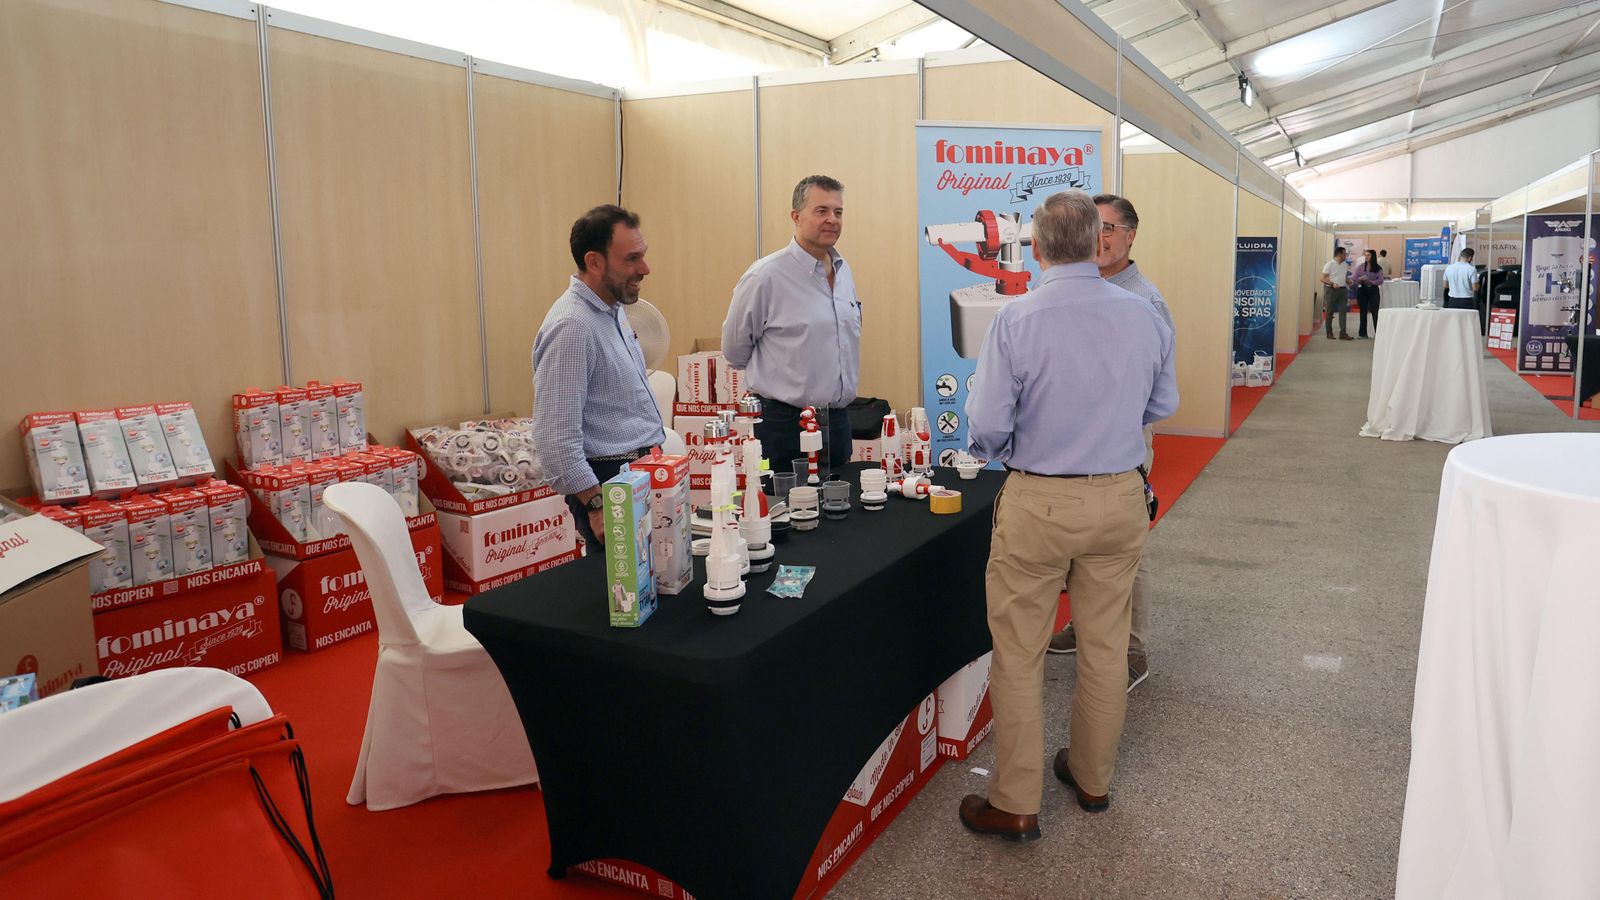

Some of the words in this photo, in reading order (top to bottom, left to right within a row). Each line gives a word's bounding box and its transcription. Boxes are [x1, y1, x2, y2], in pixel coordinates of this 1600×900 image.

[937, 169, 1012, 197] Original
[1027, 174, 1055, 190] Since
[1055, 172, 1073, 185] 1939
[1241, 307, 1271, 317] SPAS
[676, 403, 688, 412] QUE
[688, 403, 700, 413] NOS
[700, 403, 722, 414] COPIEN
[691, 477, 705, 486] NOS
[473, 500, 485, 512] QUE
[485, 498, 498, 509] NOS
[498, 494, 518, 508] COPIEN
[533, 487, 545, 499] NOS
[406, 512, 435, 530] NCANTA
[305, 542, 322, 555] QUE
[322, 539, 338, 552] NOS
[485, 539, 527, 563] Original
[113, 586, 154, 606] COPIEN
[187, 572, 212, 589] NOS
[213, 561, 262, 583] ENCANTA
[479, 581, 490, 592] QUE
[490, 578, 503, 589] NOS
[503, 572, 523, 585] COPIEN
[538, 563, 550, 572] NOS
[550, 553, 575, 570] ENCANTA
[323, 588, 372, 614] Origina
[200, 631, 227, 650] Since
[226, 624, 244, 640] 1939
[315, 632, 334, 649] NOS
[334, 619, 373, 640] ENCANTA
[103, 641, 184, 677] Original
[247, 652, 279, 671] COPIEN
[870, 802, 884, 822] QUE
[882, 790, 896, 811] NOS
[894, 770, 915, 800] COPIEN
[817, 856, 833, 881] NOS
[833, 820, 864, 863] ENCANTA
[599, 862, 650, 891] ENCANTA
